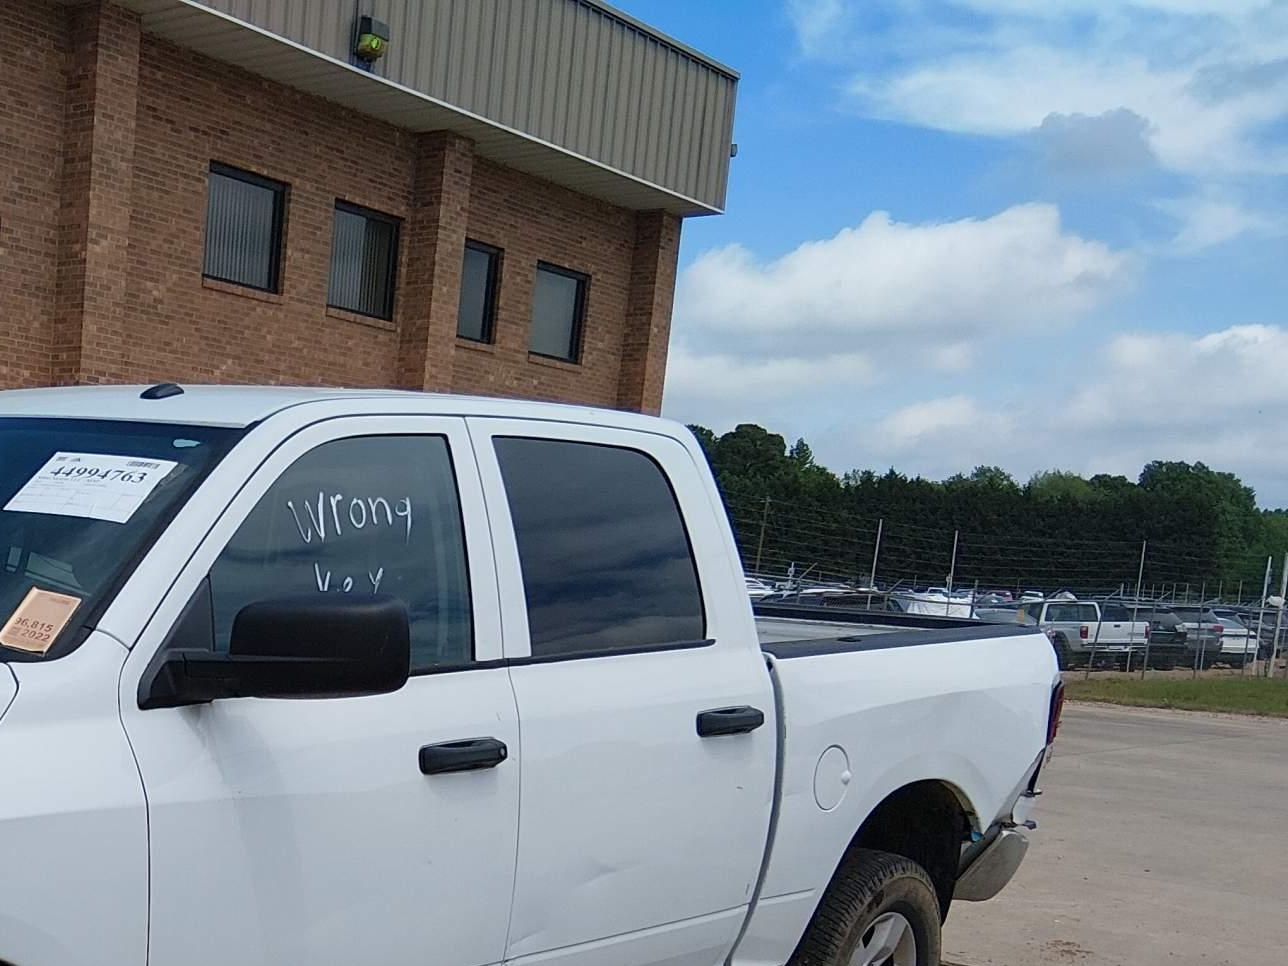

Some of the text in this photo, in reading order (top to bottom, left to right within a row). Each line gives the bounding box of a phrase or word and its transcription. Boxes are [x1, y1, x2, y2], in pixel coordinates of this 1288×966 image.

[50, 465, 148, 484] 44994763
[287, 491, 412, 545] Wrong
[22, 629, 50, 641] 2022
